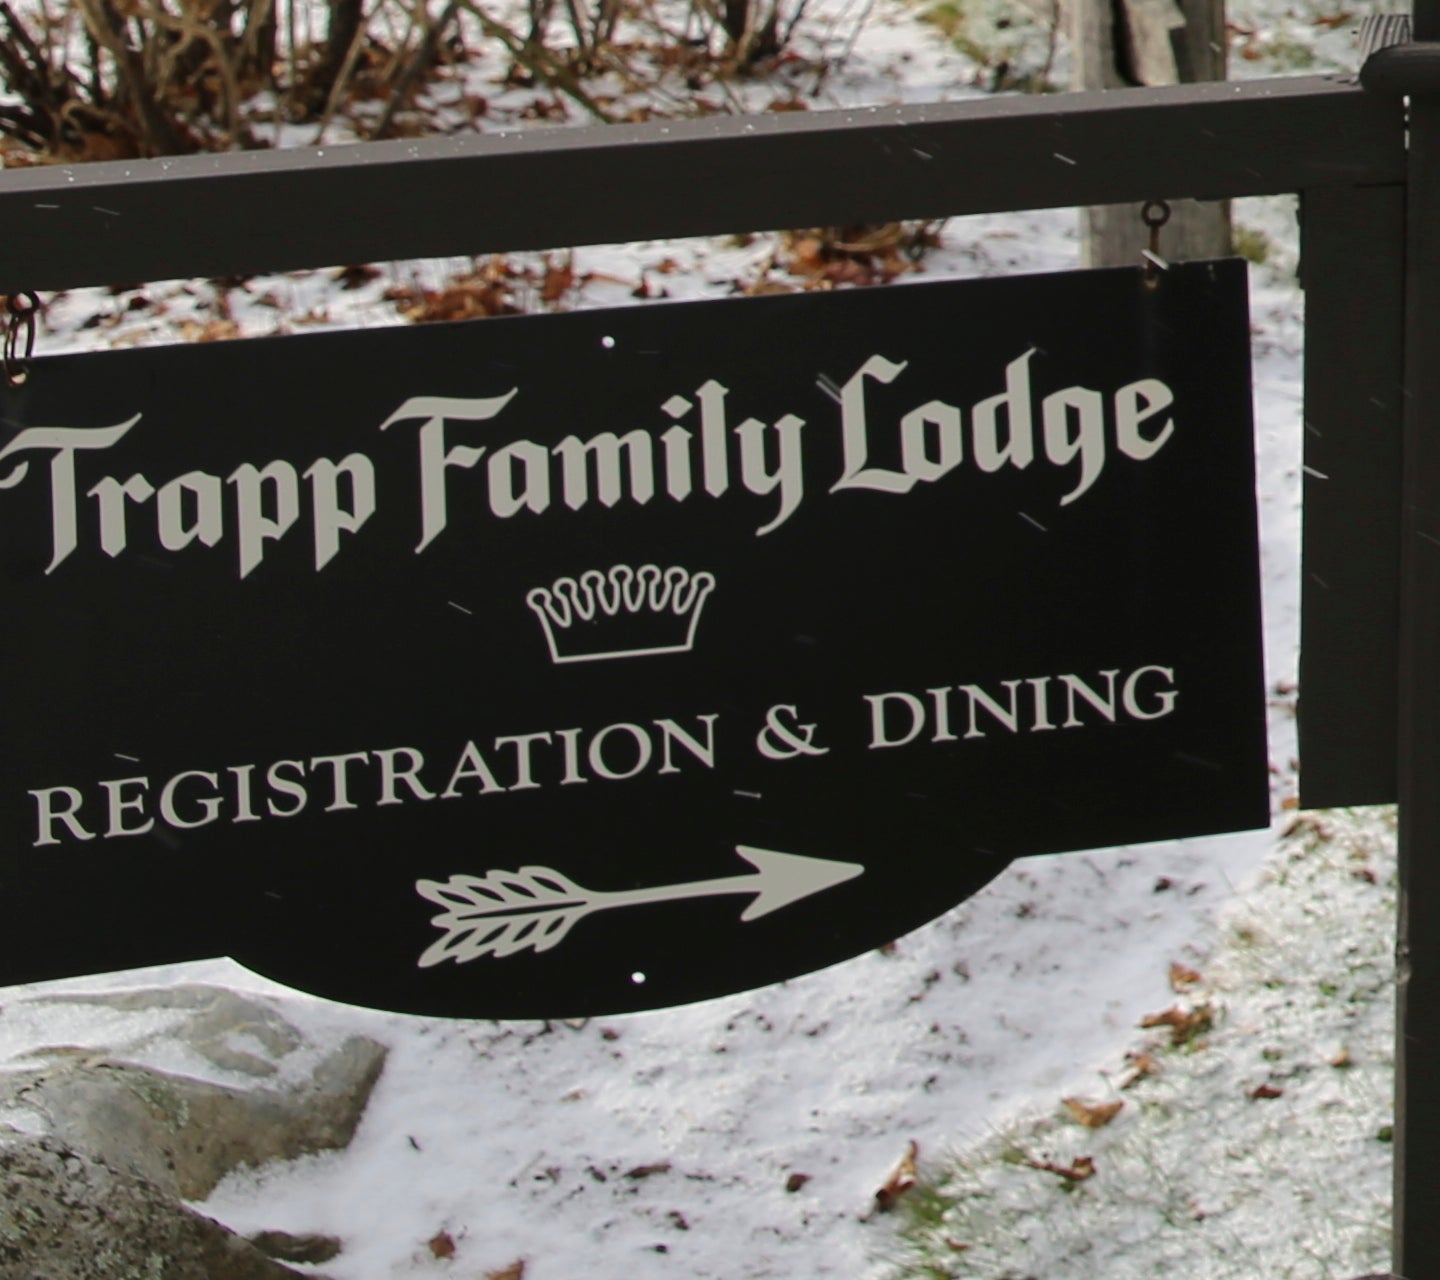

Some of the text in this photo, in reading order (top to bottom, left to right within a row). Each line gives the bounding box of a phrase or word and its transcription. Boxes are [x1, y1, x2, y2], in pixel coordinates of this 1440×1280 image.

[0, 347, 1175, 579] Trapp Family Lodge
[27, 665, 1179, 847] REGISTRATION & DINING
